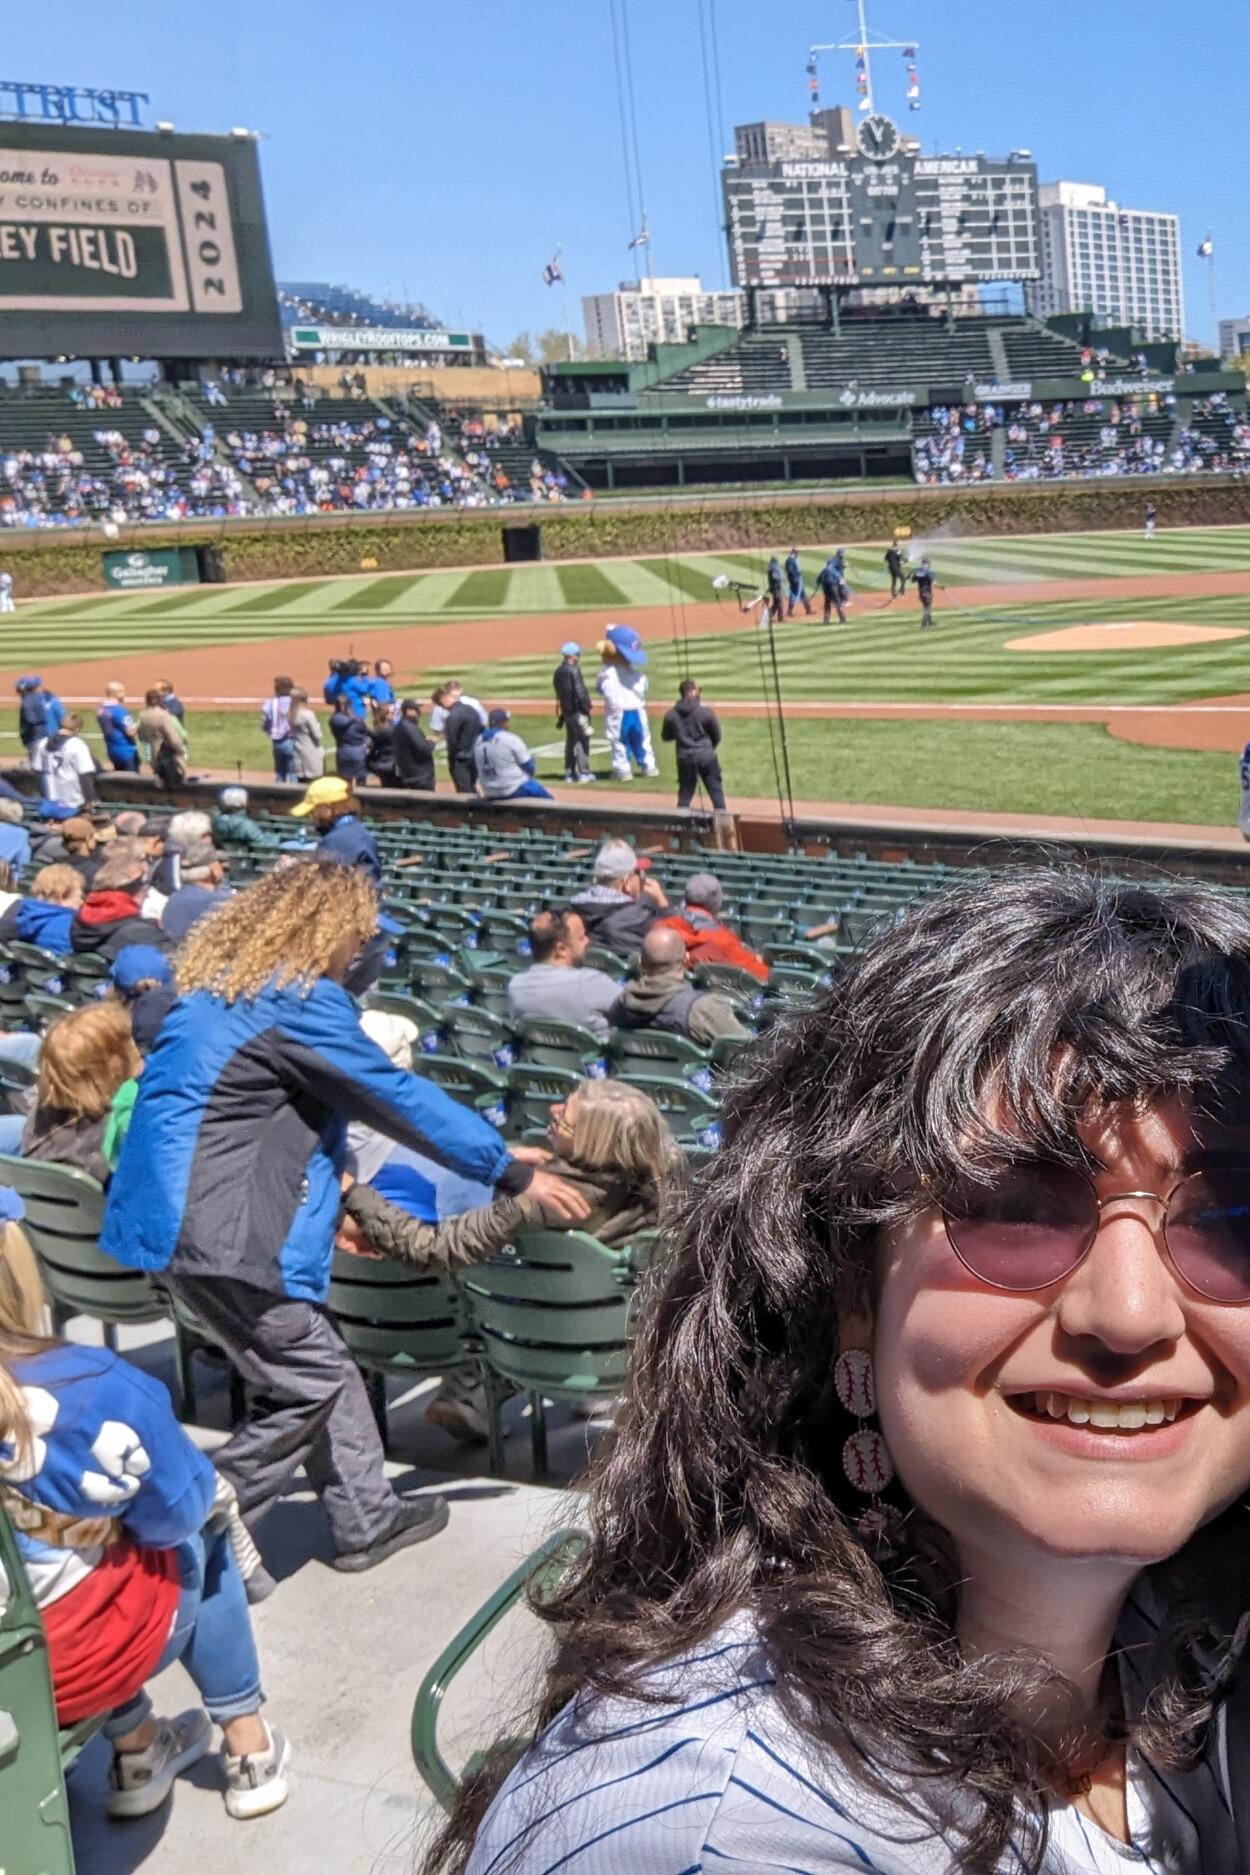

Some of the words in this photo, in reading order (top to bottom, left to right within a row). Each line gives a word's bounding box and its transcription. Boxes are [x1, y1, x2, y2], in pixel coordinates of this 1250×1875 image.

[782, 162, 849, 177] NATIONAL
[914, 160, 978, 175] AMERICAN
[41, 168, 58, 185] to
[15, 195, 118, 213] CONFINES
[50, 228, 137, 279] FIELD
[1090, 379, 1175, 396] Budweiser
